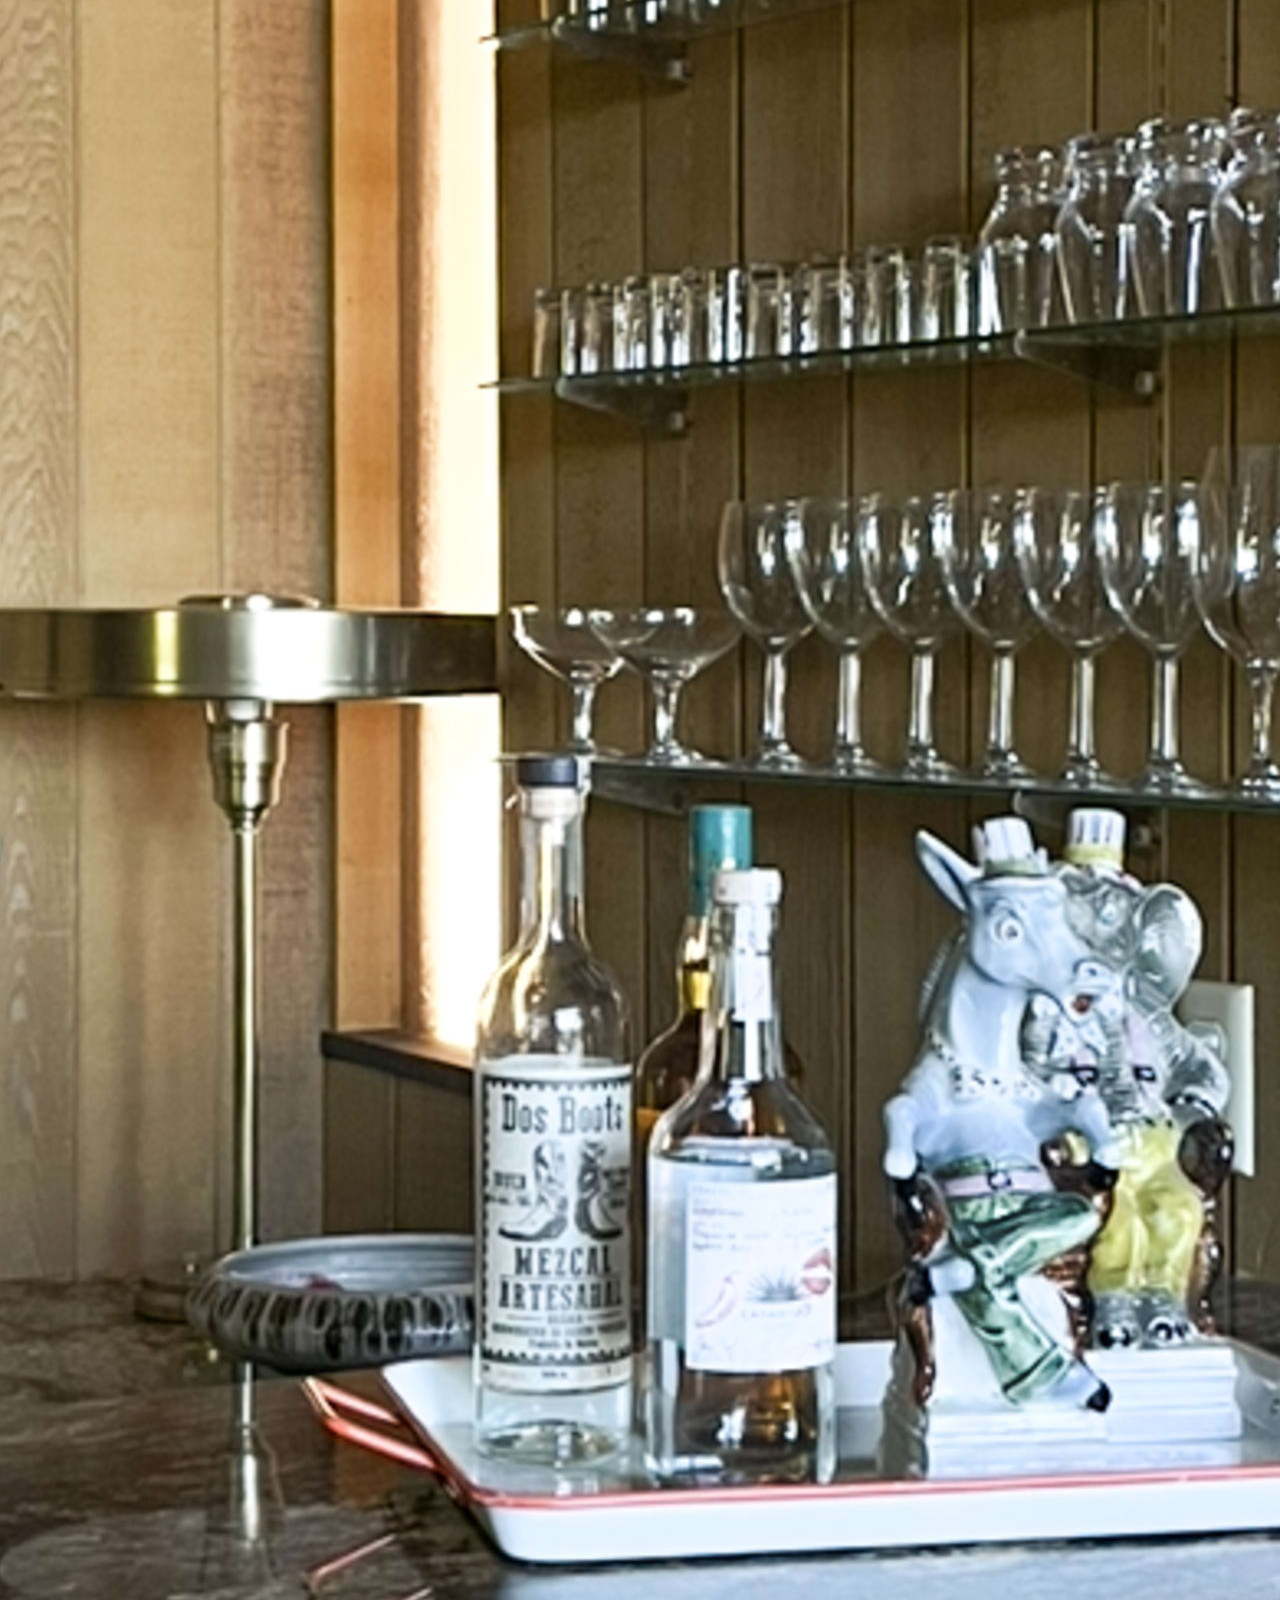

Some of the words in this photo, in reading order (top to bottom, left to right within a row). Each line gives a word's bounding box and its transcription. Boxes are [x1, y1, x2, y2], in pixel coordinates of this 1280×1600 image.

[501, 1093, 548, 1134] Dos
[558, 1094, 624, 1134] Boots
[514, 1245, 612, 1276] MEZCAL
